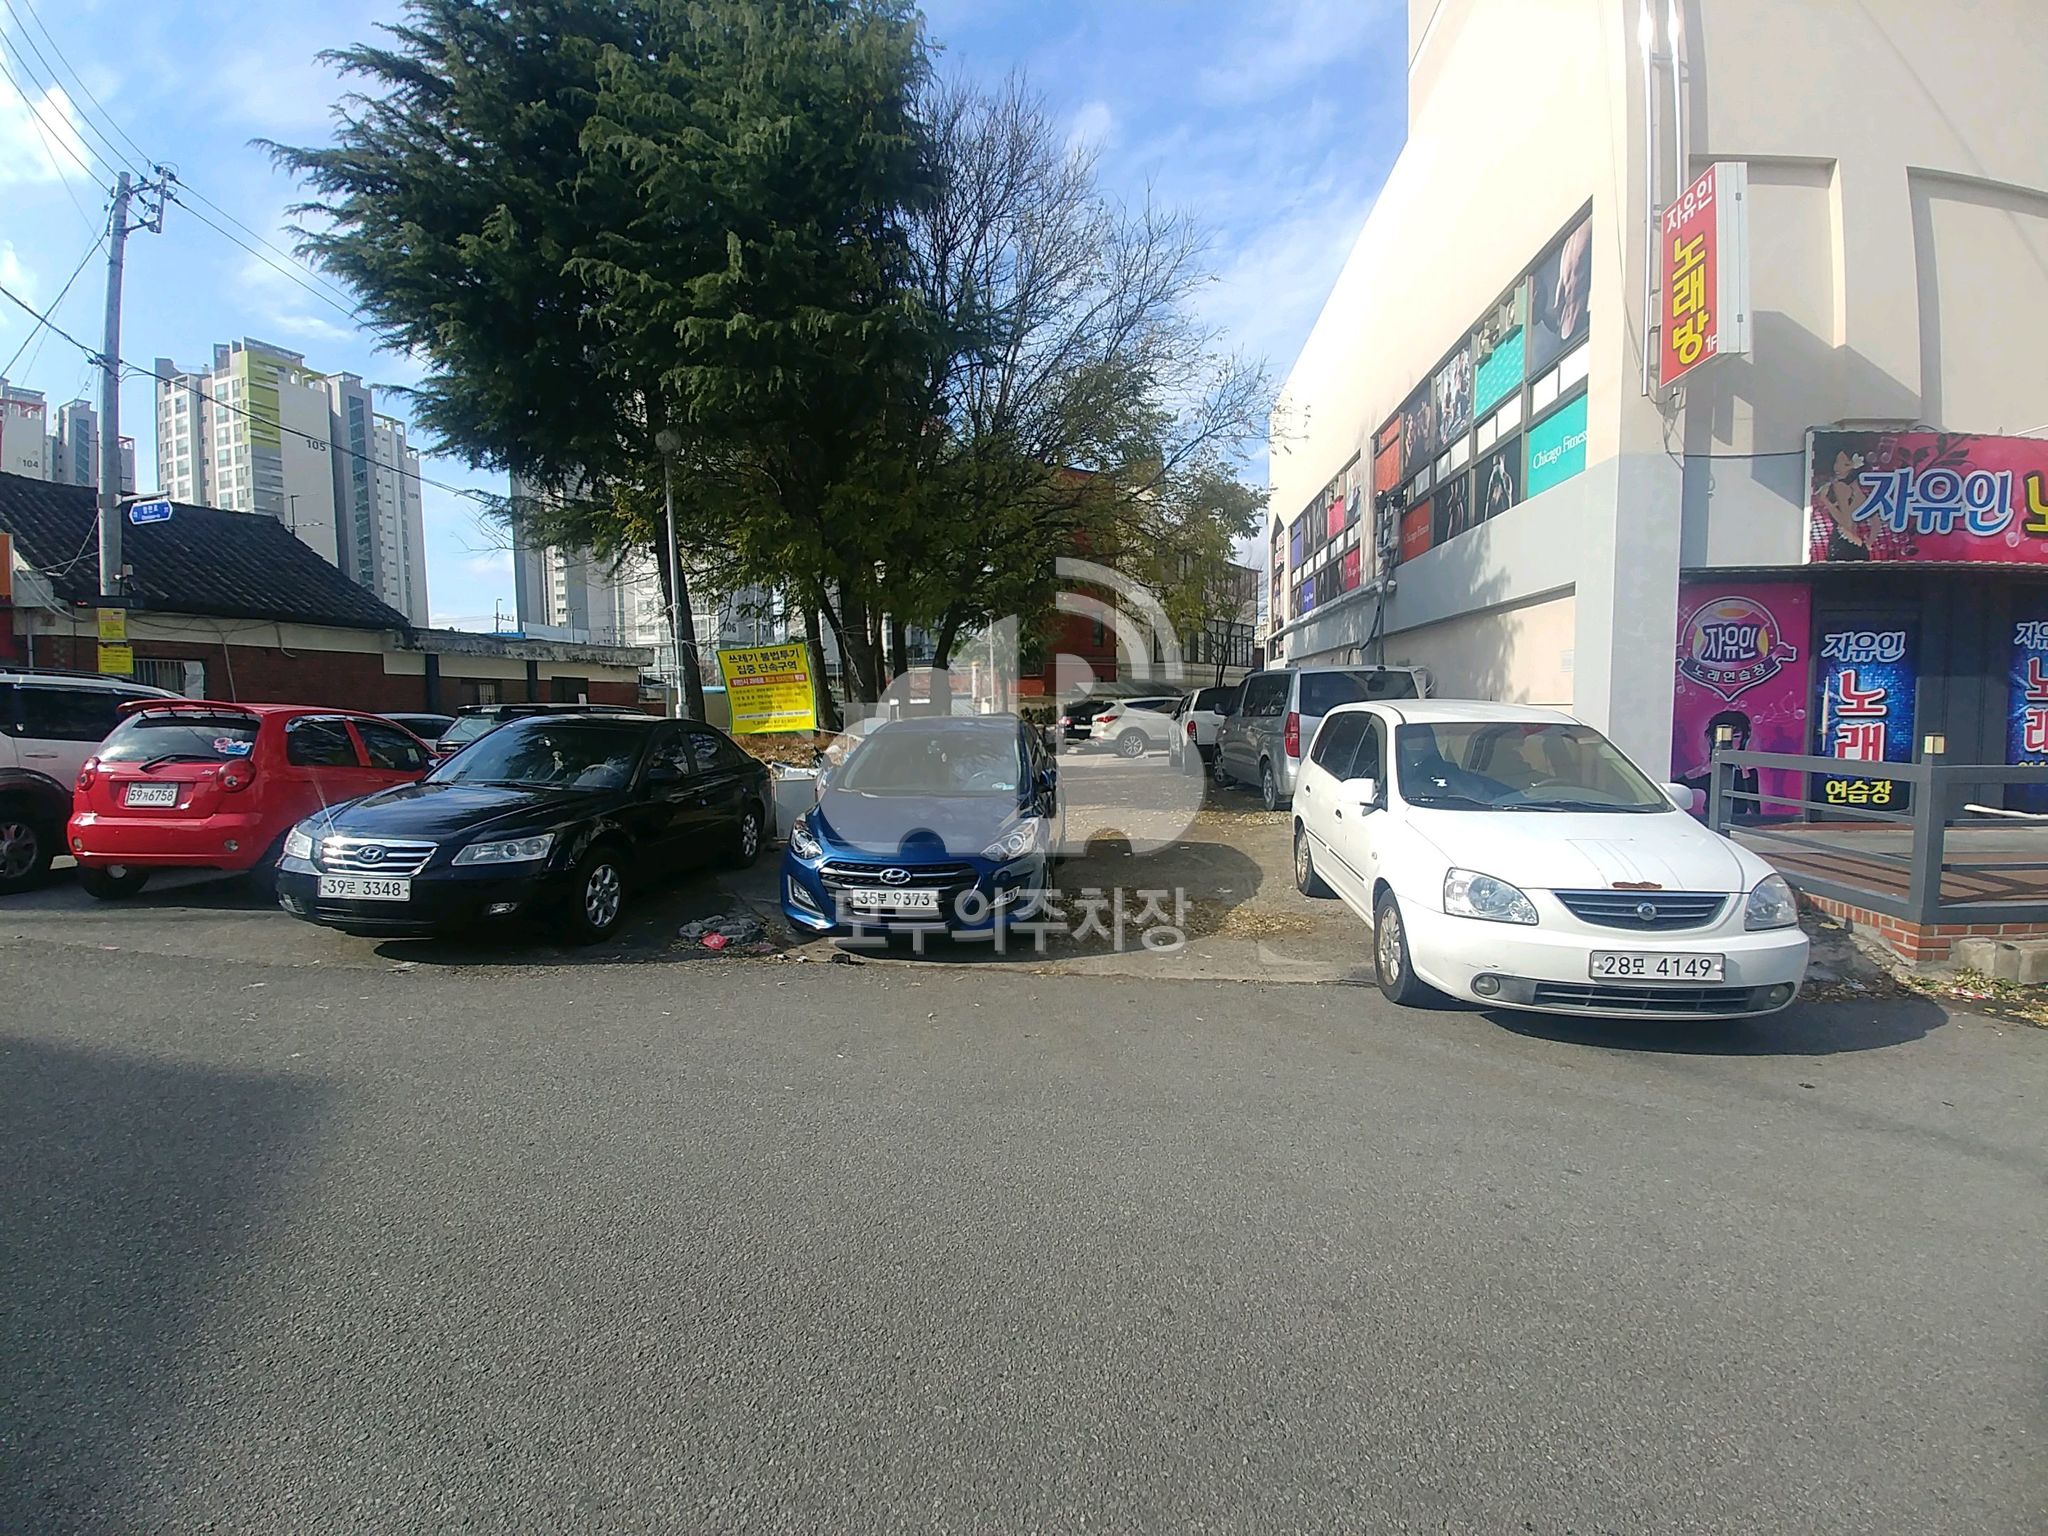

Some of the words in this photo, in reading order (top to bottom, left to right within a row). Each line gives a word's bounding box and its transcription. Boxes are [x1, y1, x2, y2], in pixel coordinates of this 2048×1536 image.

[1667, 174, 1713, 233] 자유인
[1671, 233, 1710, 365] 노래방
[306, 439, 327, 452] 105
[1532, 446, 1562, 469] Chicago
[1562, 430, 1587, 453] Fitnes
[22, 459, 39, 469] 104
[1852, 467, 2013, 536] 자유인
[1703, 625, 1758, 660] 자유인
[1821, 632, 1905, 662] 자유인
[728, 652, 758, 664] 쓰레기
[760, 648, 799, 662] 불법투기
[736, 663, 756, 675] 집중
[758, 661, 798, 673] 단속구역
[1692, 662, 1767, 683] 노래연습장
[1834, 670, 1888, 761] 노래
[1825, 780, 1893, 804] 연습장
[328, 879, 356, 895] 39로
[362, 881, 401, 896] 3348
[860, 891, 887, 905] 35부
[893, 892, 930, 906] 9373
[1604, 956, 1646, 975] 28모
[1656, 958, 1712, 977] 4149
